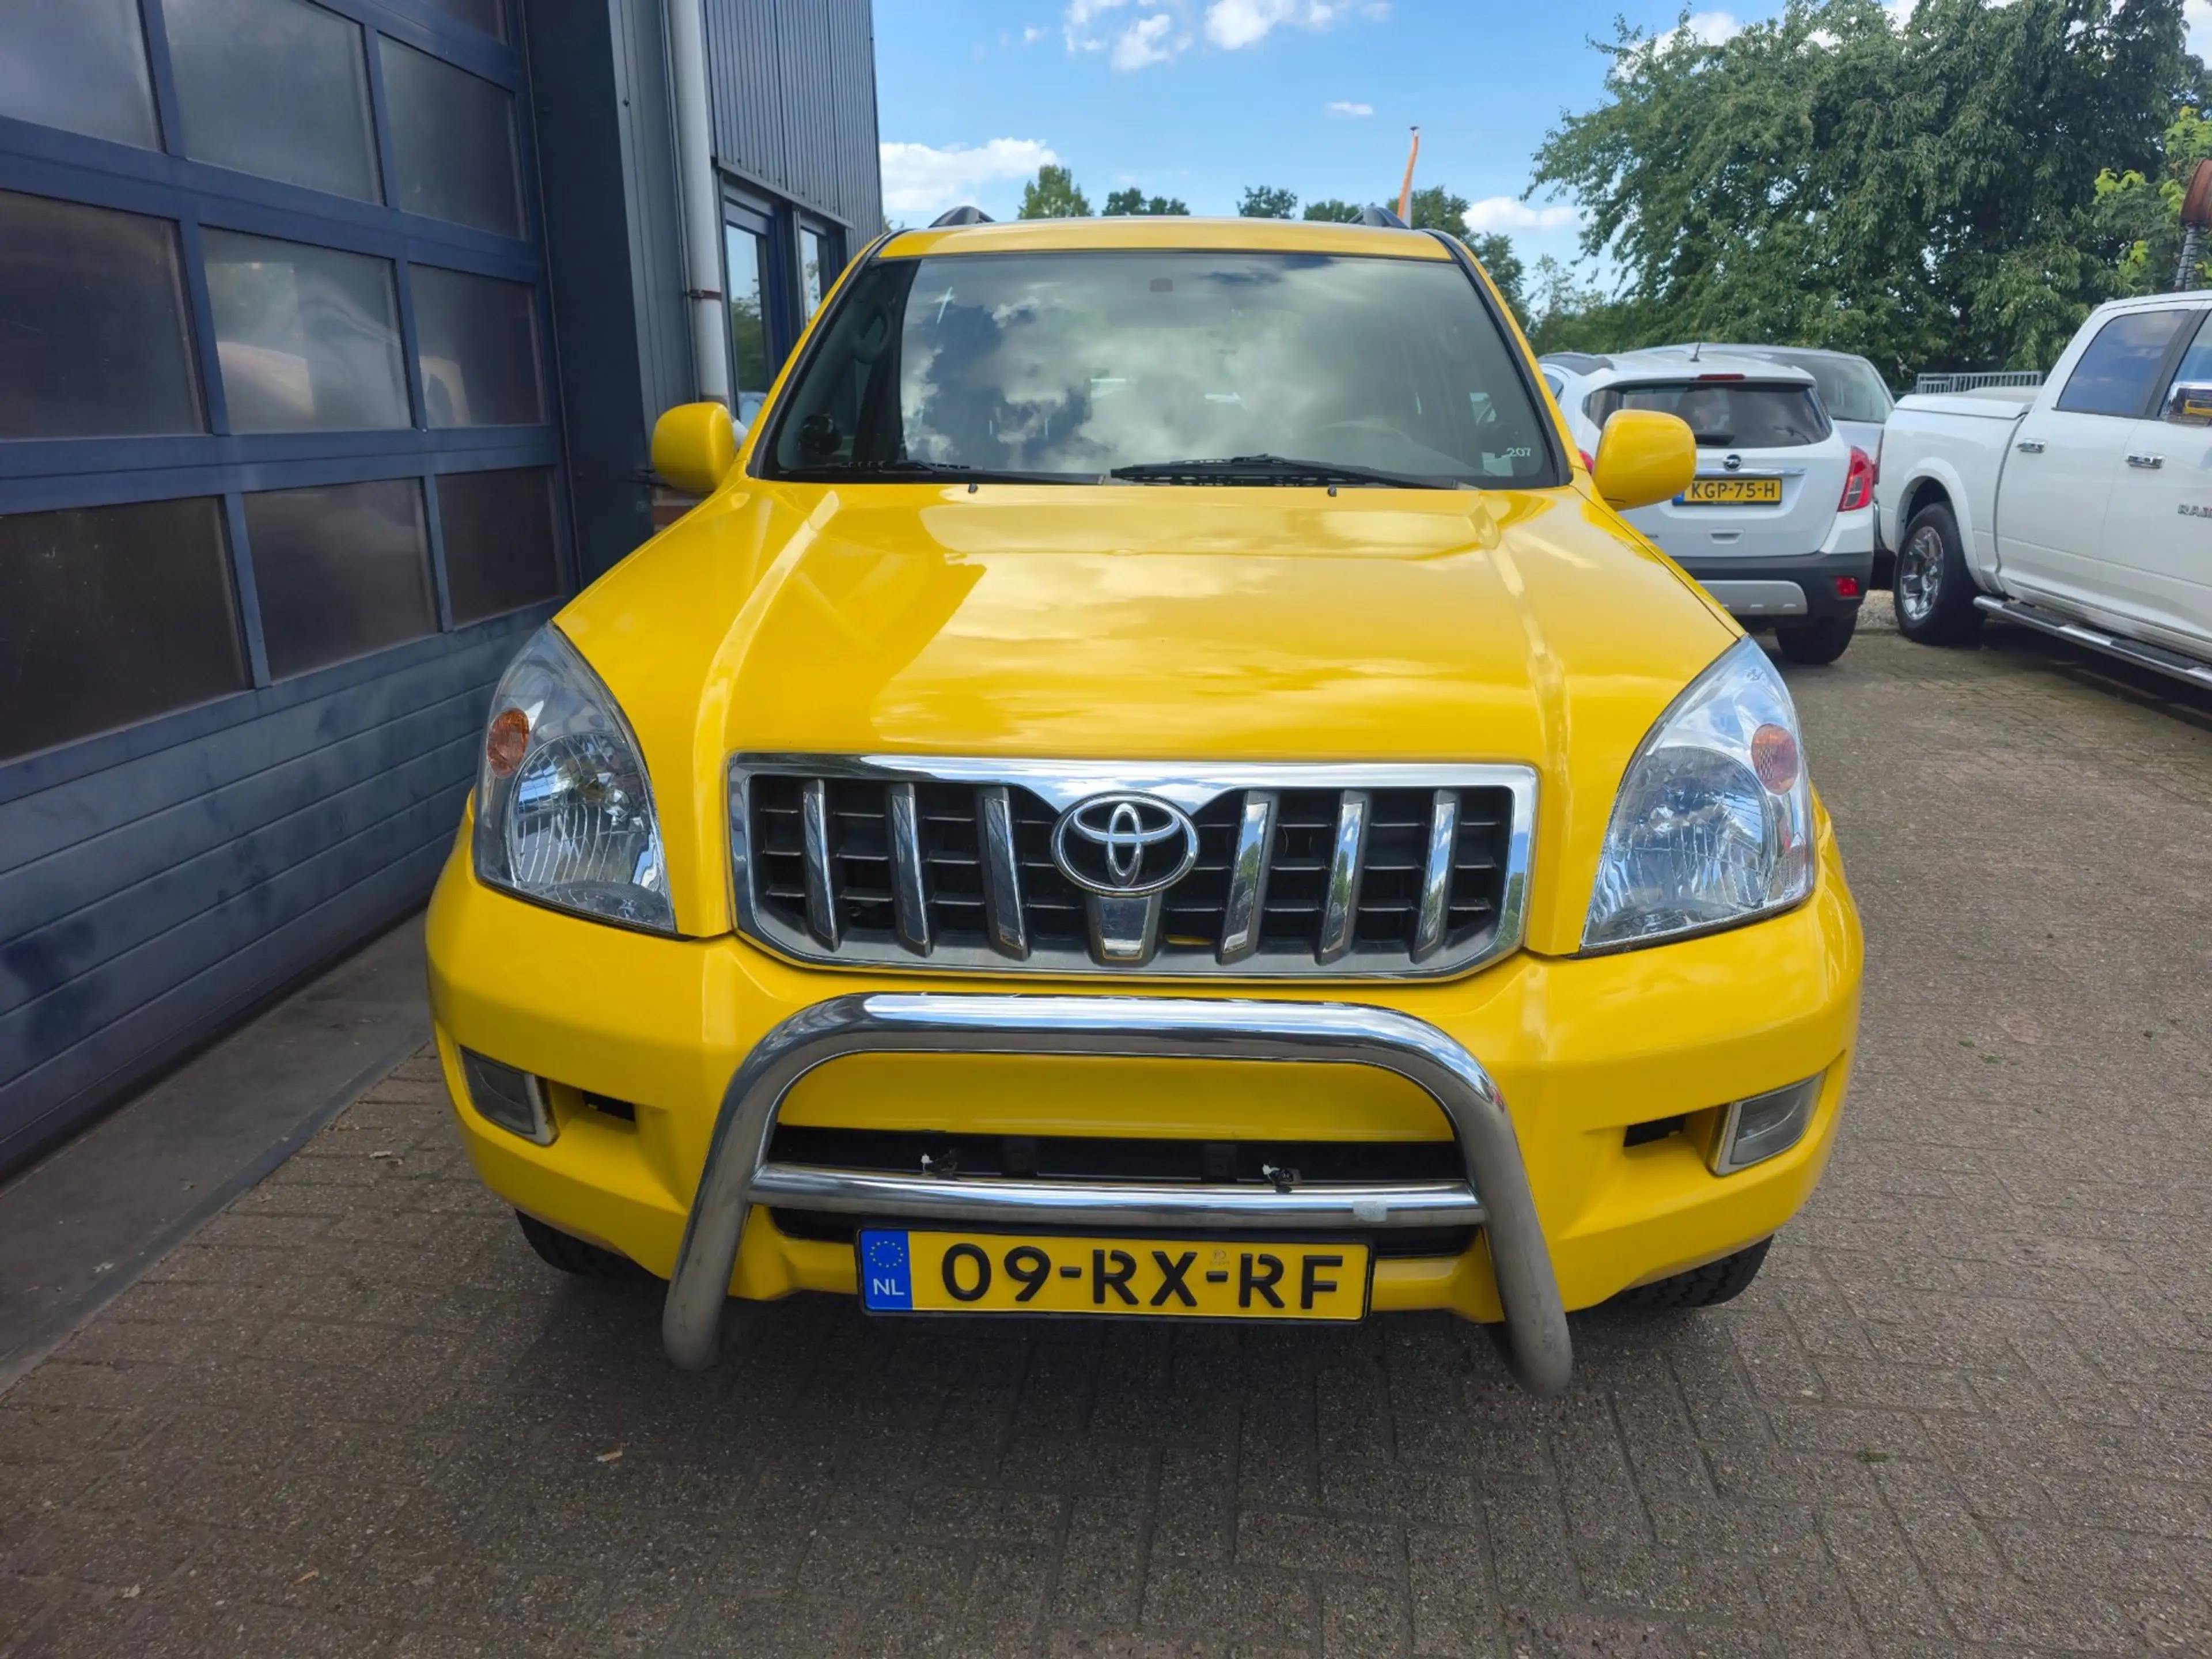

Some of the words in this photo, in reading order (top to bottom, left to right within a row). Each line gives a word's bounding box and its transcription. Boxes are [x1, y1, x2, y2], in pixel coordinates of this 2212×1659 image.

[1691, 482, 1775, 499] KGP-75-H
[941, 1243, 1343, 1310] 09-RX-RF
[873, 1278, 905, 1296] NL
